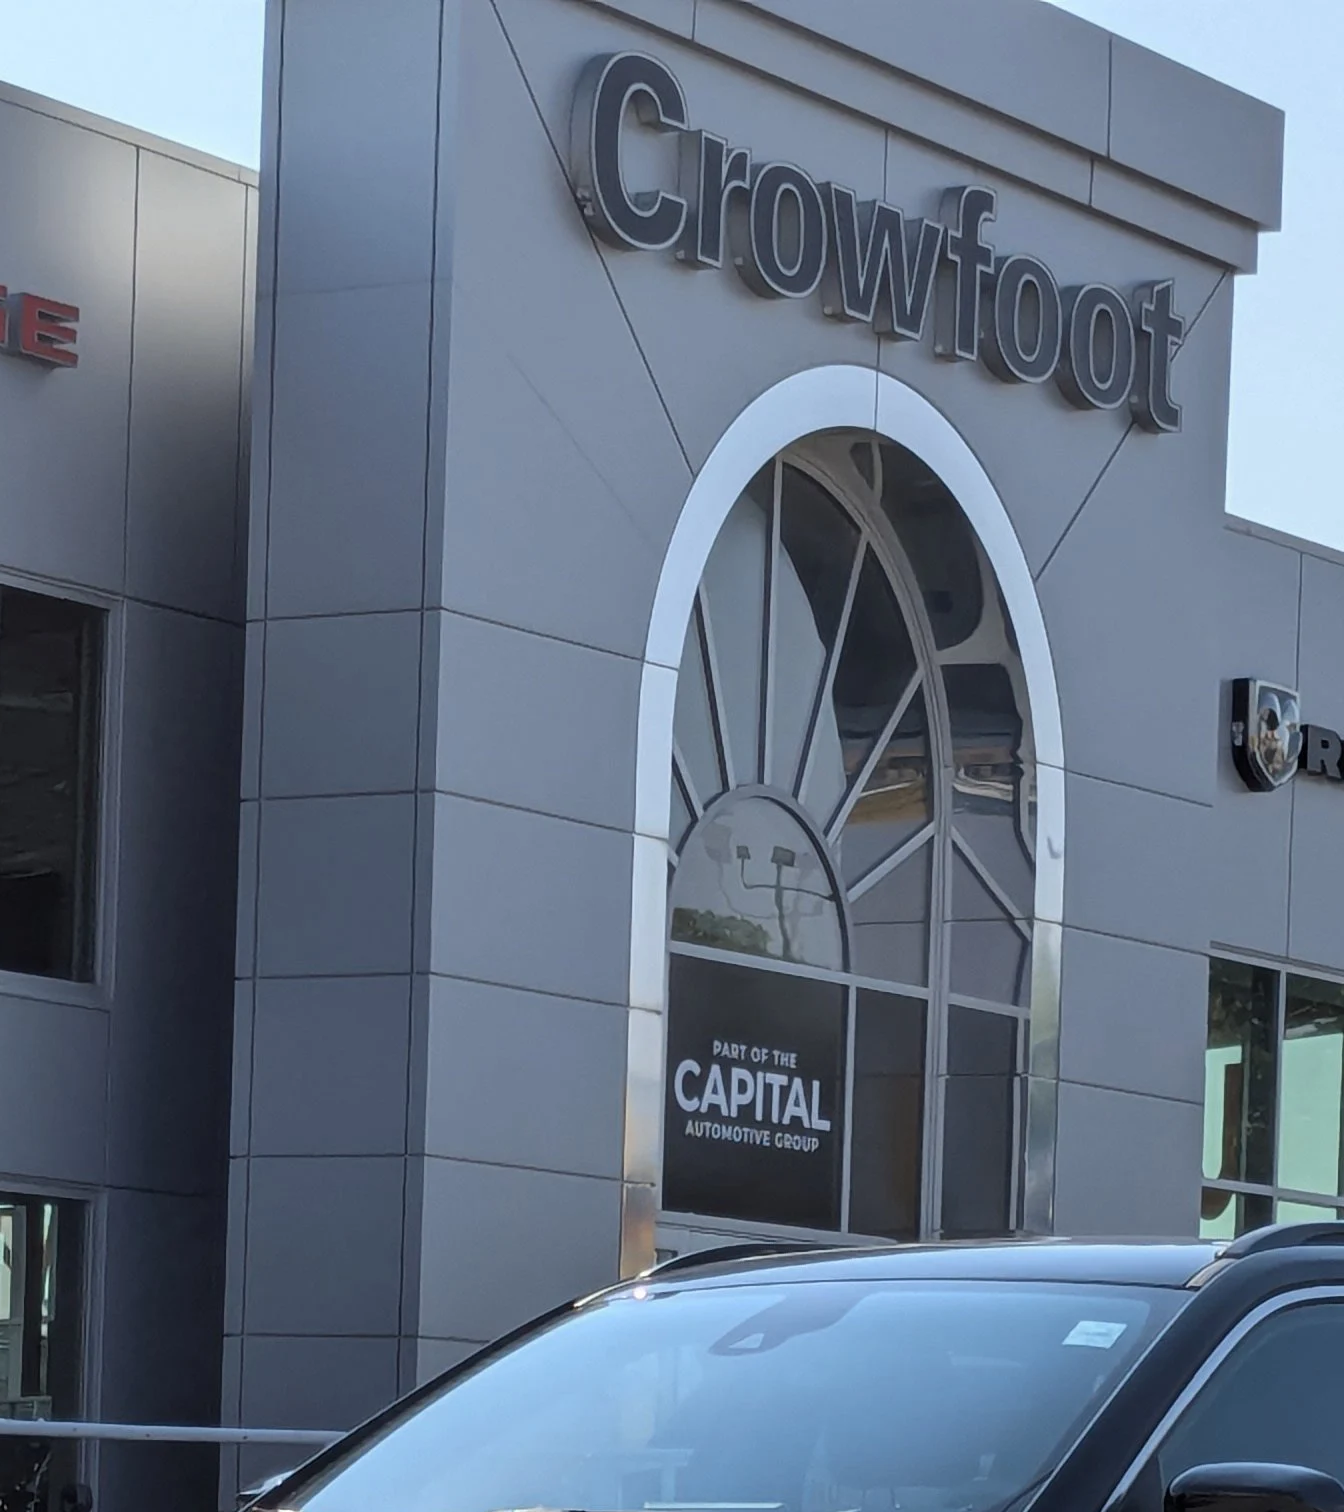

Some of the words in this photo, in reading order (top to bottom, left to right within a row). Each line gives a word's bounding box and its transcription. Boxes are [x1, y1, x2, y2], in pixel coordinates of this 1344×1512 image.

[572, 50, 1184, 433] Crowfoot
[712, 1039, 748, 1061] PART
[750, 1046, 769, 1064] OF
[772, 1049, 799, 1069] THE
[673, 1058, 832, 1132] CAPITAL
[684, 1119, 771, 1148] AUTOMOTIVE
[774, 1132, 820, 1153] GROUP
